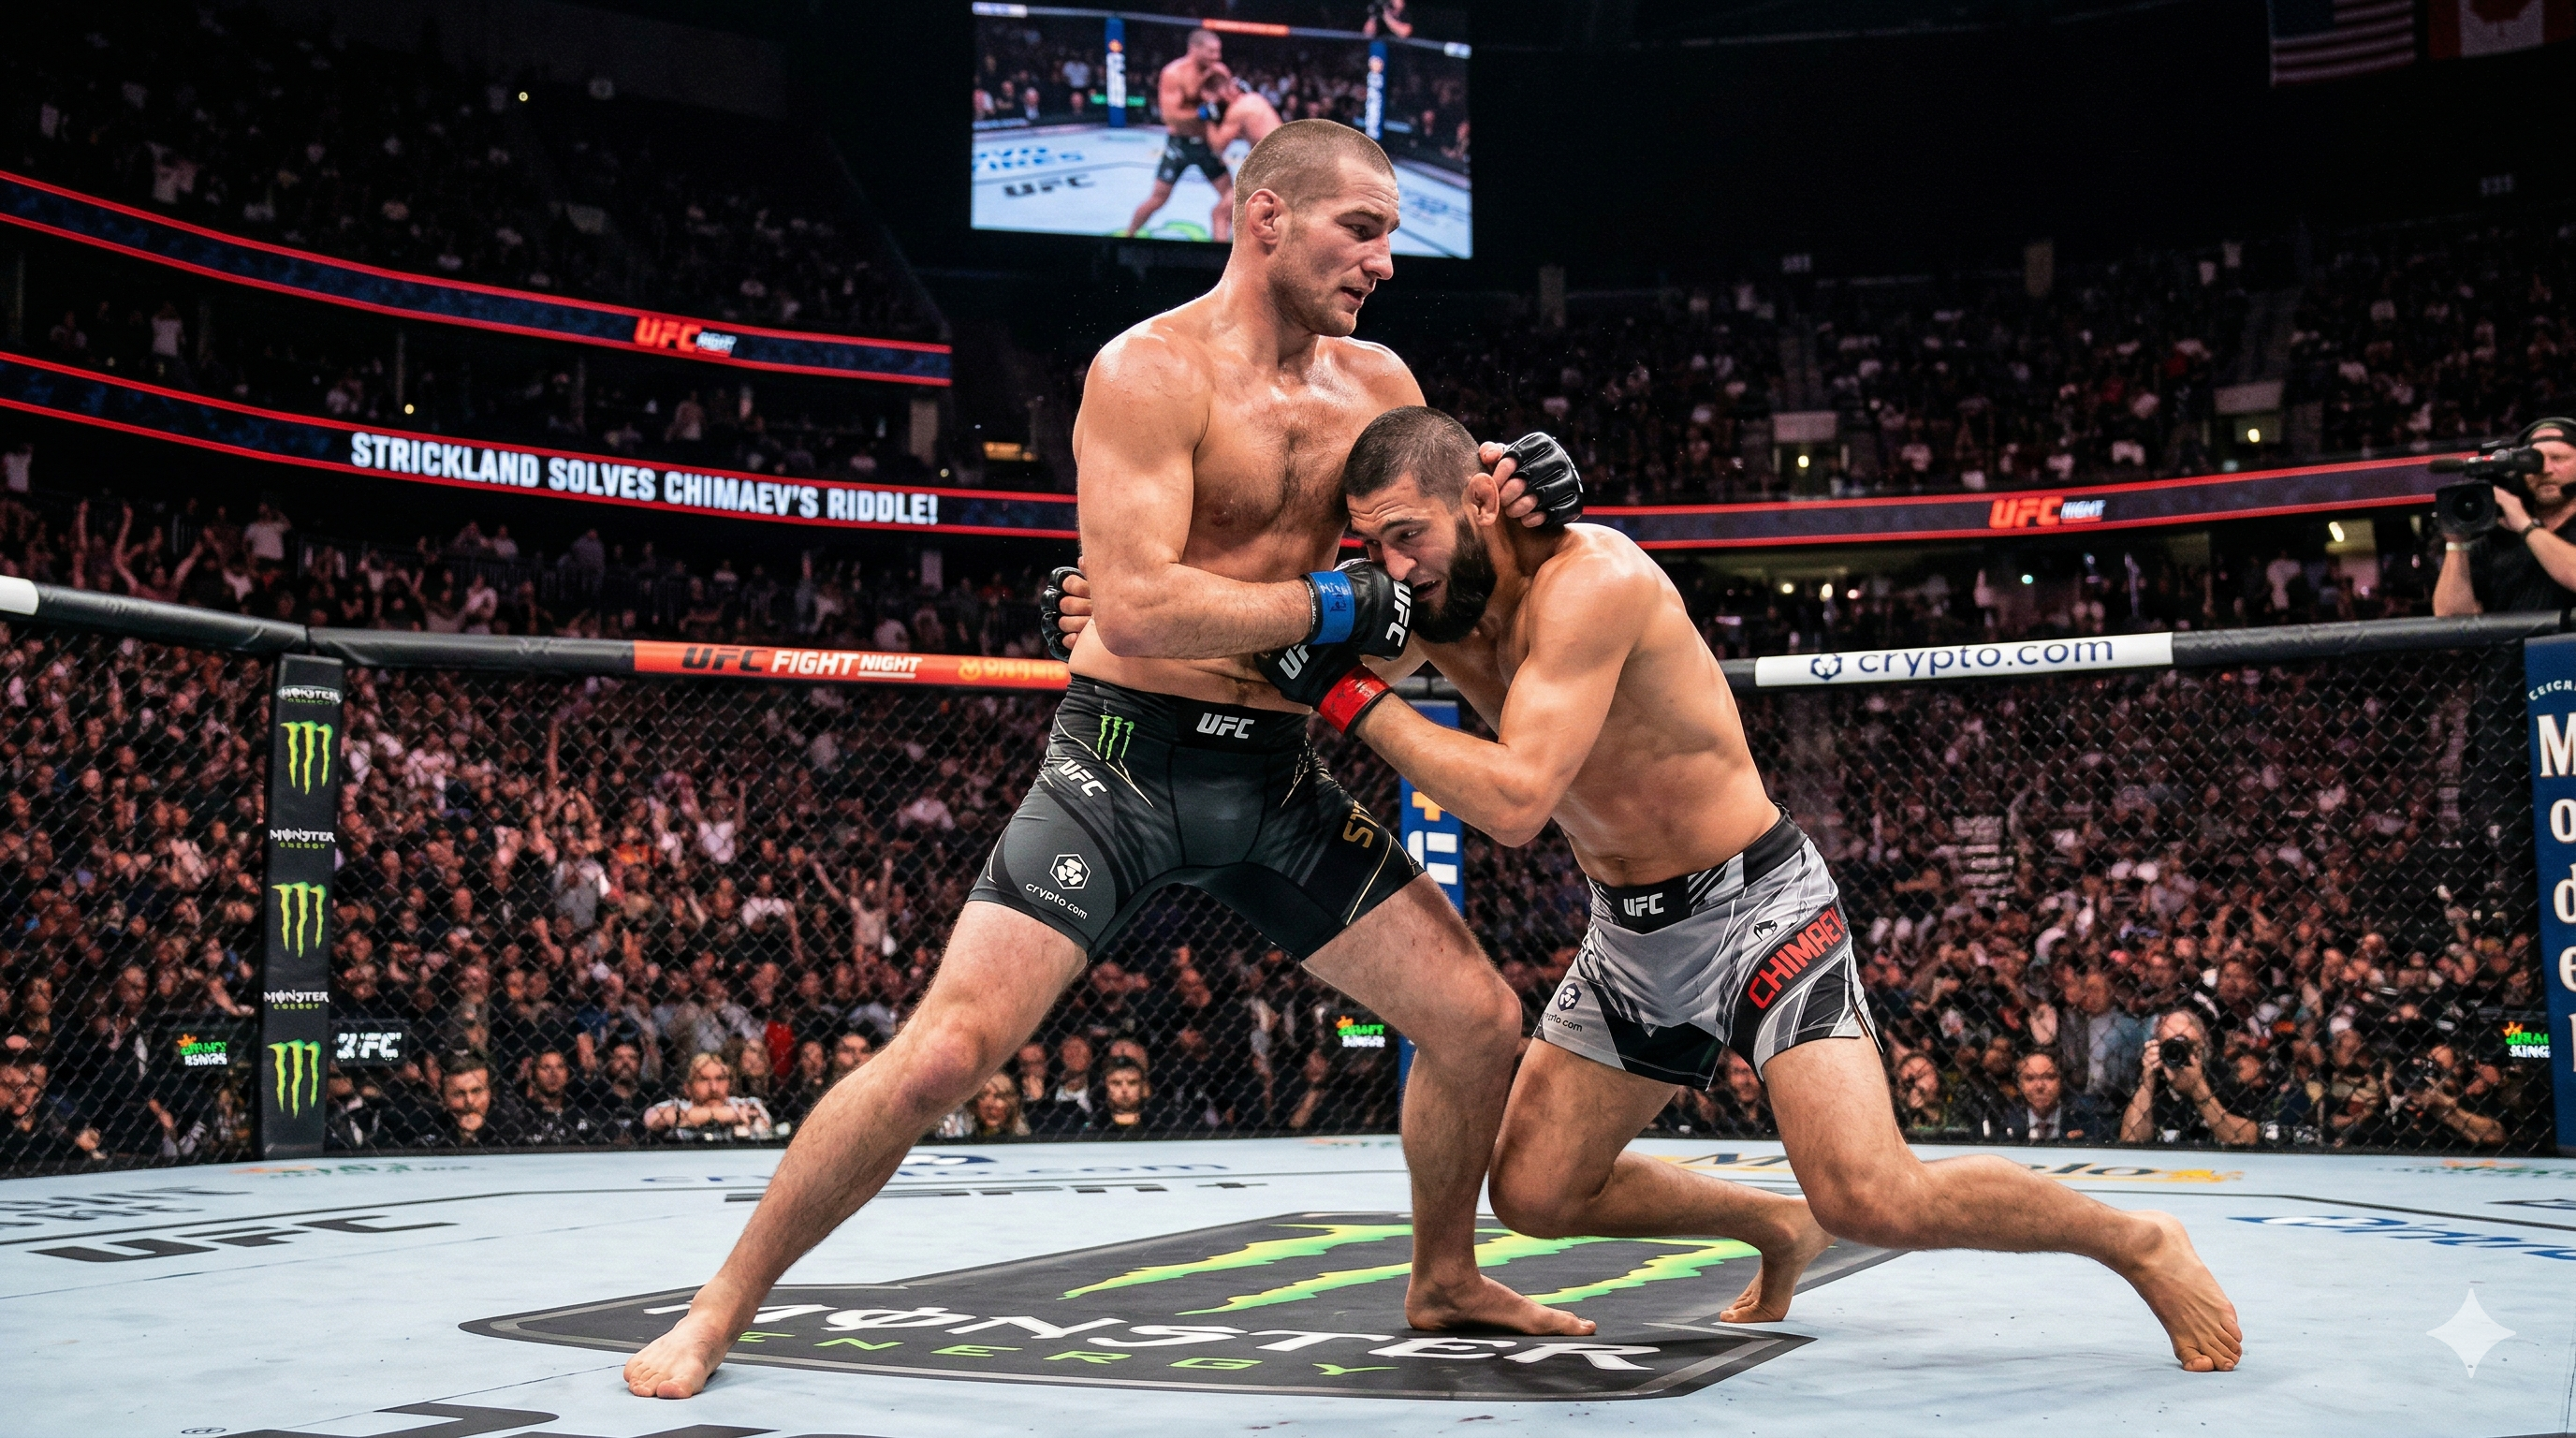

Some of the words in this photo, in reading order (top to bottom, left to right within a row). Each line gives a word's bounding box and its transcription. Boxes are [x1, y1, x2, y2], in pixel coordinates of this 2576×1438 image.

[634, 317, 702, 353] UFC
[351, 432, 539, 489] STRICKLAND
[548, 456, 655, 502] SOLVES
[664, 471, 819, 519] CHIMAEV'S
[827, 489, 939, 525] RIDDLE!
[1989, 496, 2064, 529] UFC
[1385, 580, 1412, 647] UFC
[681, 647, 763, 672] UFC
[770, 650, 860, 676] FIGHT
[862, 653, 923, 673] NIGHT
[1279, 644, 1310, 680] UF
[1859, 640, 2113, 676] crypto.com
[1196, 712, 1255, 740] UFC
[1059, 758, 1107, 797] UFC
[1623, 892, 1664, 917] UFC
[1748, 906, 1846, 1009] CHIMAEV
[26, 1215, 460, 1262] UFC
[737, 1331, 1399, 1376] ENERGY
